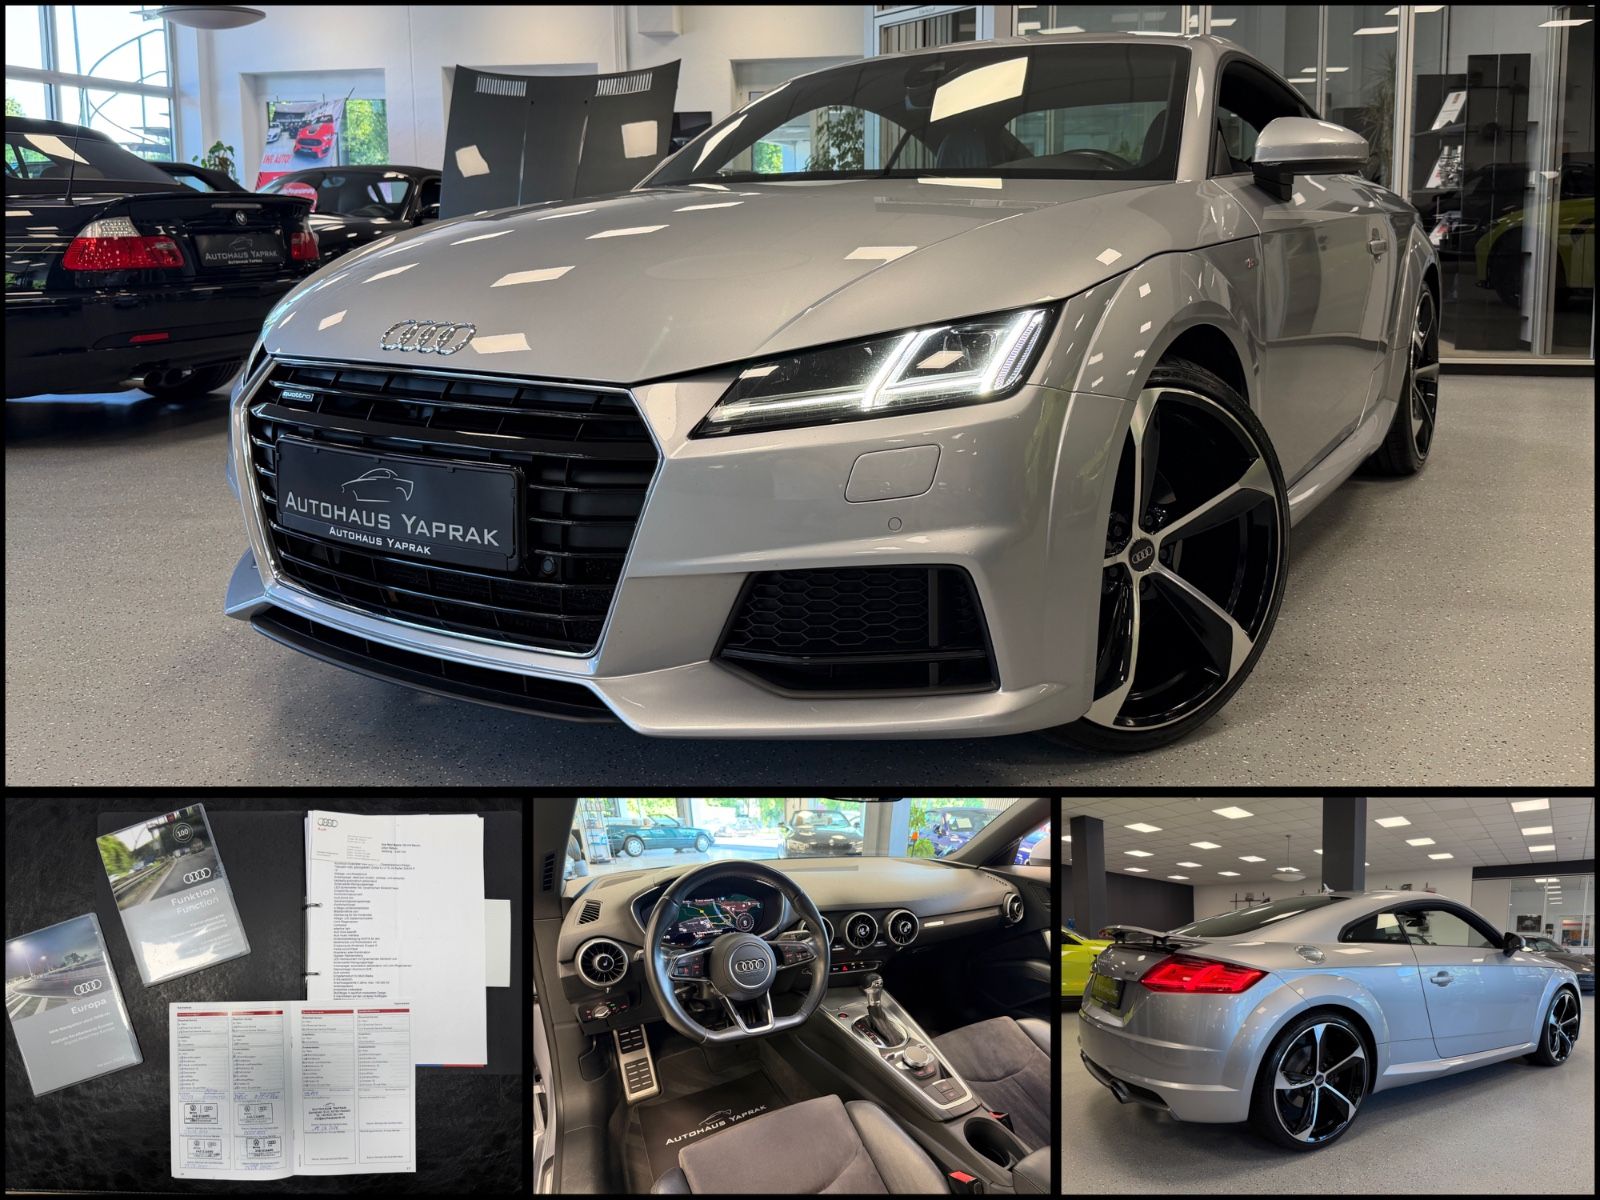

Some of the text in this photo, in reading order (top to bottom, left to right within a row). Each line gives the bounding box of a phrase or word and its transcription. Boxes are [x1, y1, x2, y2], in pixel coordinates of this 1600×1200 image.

[205, 250, 278, 261] AUTOHAUS YAPRAK
[282, 391, 312, 400] quattro
[285, 491, 500, 547] AUTOHAUS YAPRAK
[329, 526, 432, 555] AUTOHAUS YAPRAK
[176, 828, 190, 838] 100
[171, 886, 216, 906] Funktion
[176, 896, 219, 915] Function
[70, 998, 107, 1016] Europa
[665, 1104, 767, 1146] AUTOHAUS YAPRAK
